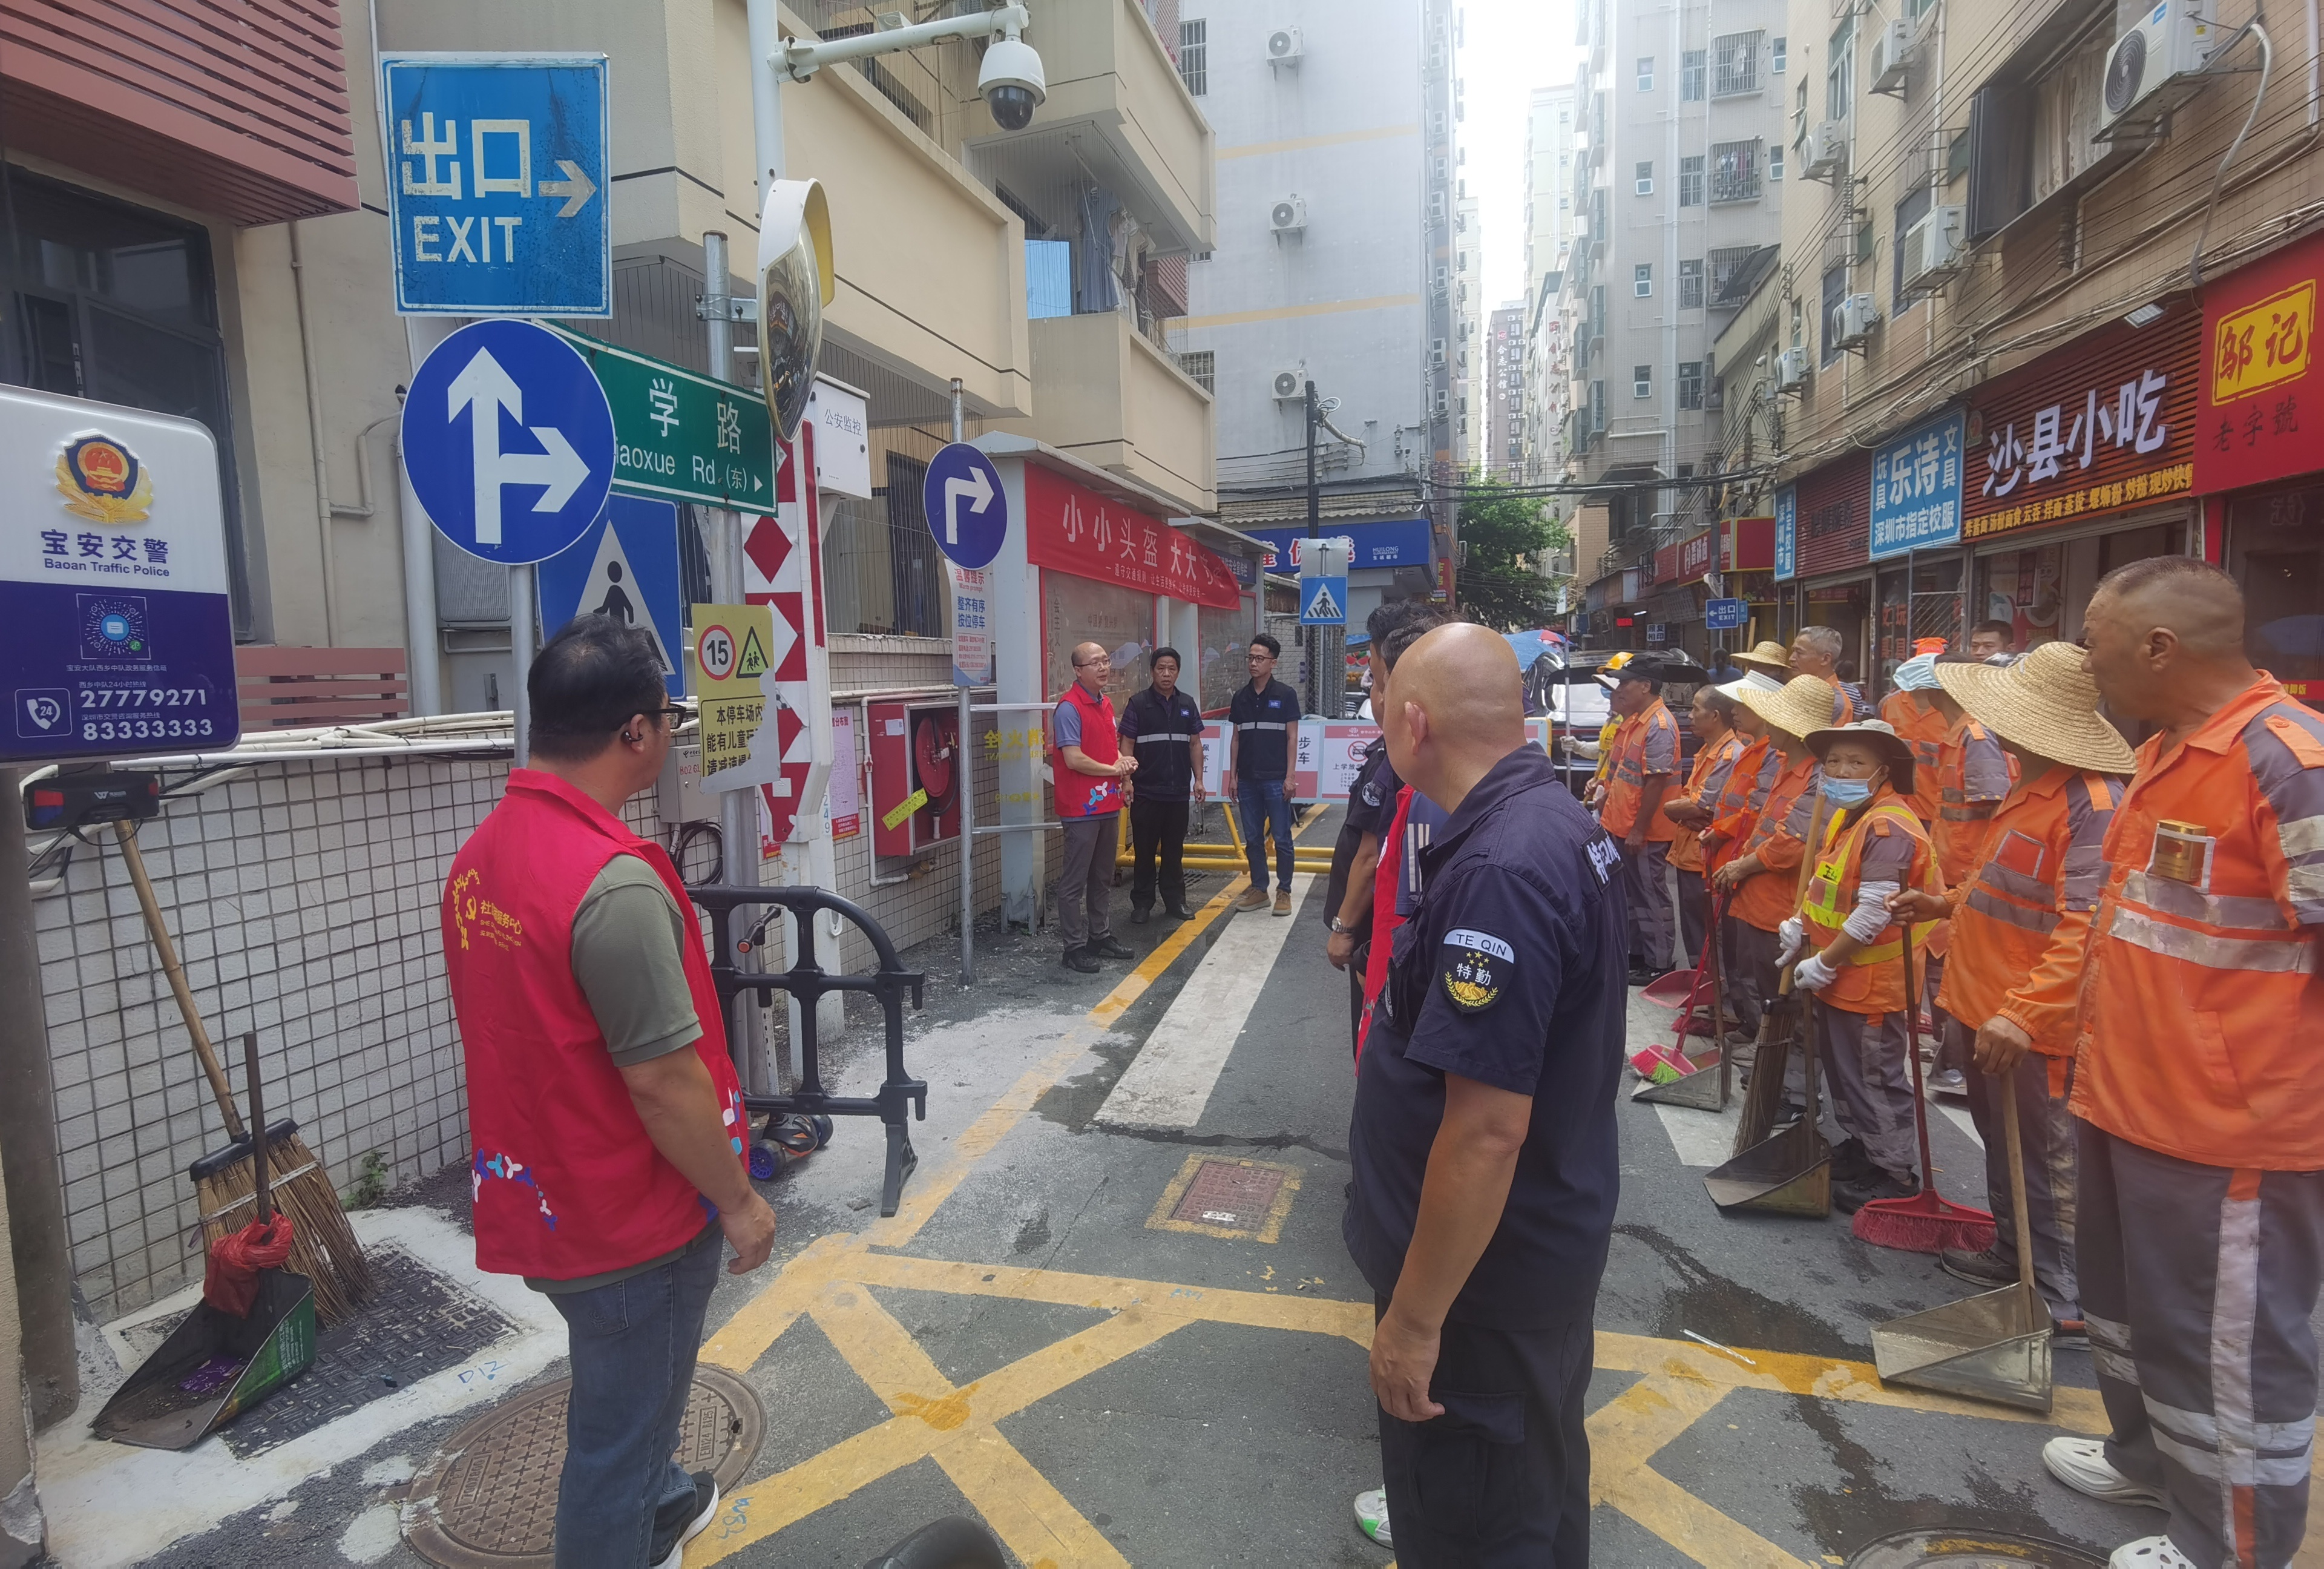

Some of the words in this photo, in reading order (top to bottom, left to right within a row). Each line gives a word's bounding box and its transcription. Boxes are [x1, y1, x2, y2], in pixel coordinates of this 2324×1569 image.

[401, 112, 533, 200] 出口
[415, 216, 522, 263] EXIT
[824, 409, 862, 436] 公安监控
[1983, 369, 2167, 498] 沙县小吃
[2213, 395, 2298, 452] 老字號
[615, 436, 675, 475] iaoxue
[692, 455, 715, 485] Rd
[1889, 432, 1940, 505] 乐诗
[1942, 424, 1958, 490] 文具
[1875, 453, 1887, 511] 玩具
[1063, 494, 1158, 567] 小小头盔
[1874, 500, 1955, 547] 深圳市指定校服
[41, 528, 168, 564] 宝安交警
[44, 558, 87, 571] Baoan
[90, 562, 130, 574] Traffic
[134, 565, 169, 576] Police
[957, 613, 986, 630] 按位停车
[1718, 605, 1735, 614] 出口
[707, 639, 729, 665] 15
[40, 706, 53, 716] 24
[80, 689, 206, 708] 27779271
[83, 719, 213, 740] 83333333
[1456, 934, 1474, 946] TE
[1481, 939, 1506, 956] QIN
[1456, 963, 1491, 985] 特勤
